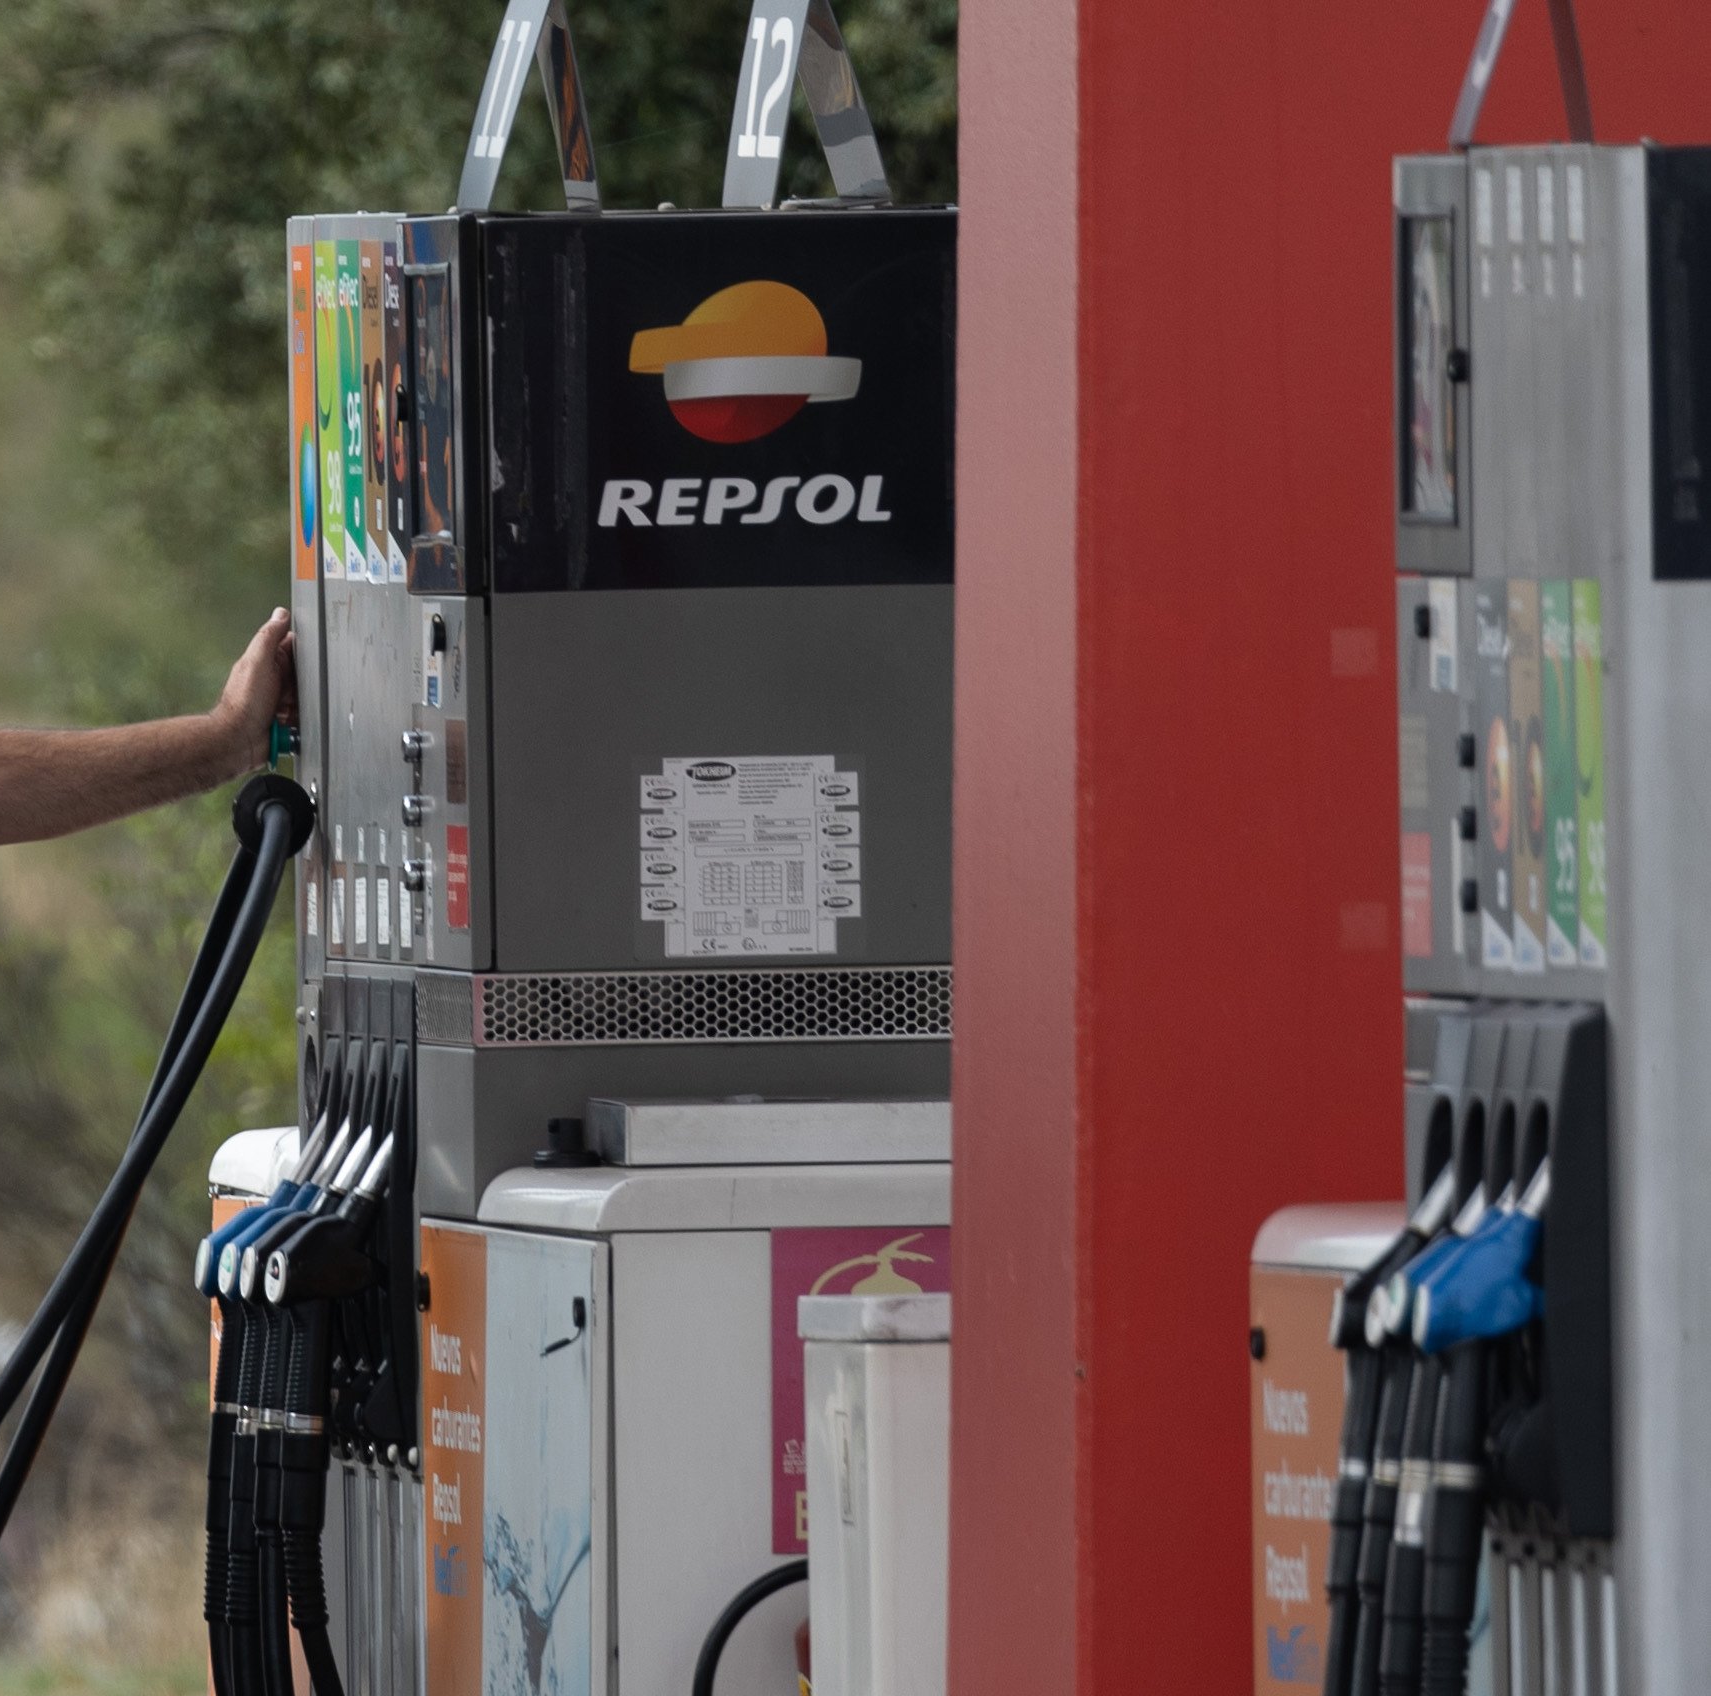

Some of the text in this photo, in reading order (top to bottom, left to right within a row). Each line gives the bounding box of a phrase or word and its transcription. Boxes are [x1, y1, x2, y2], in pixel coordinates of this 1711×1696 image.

[473, 19, 532, 159] 11
[737, 16, 794, 158] 12
[346, 391, 362, 457] 95
[327, 449, 343, 516] 98
[597, 474, 893, 527] REPSOL
[430, 1323, 462, 1375] Nuevos
[431, 1394, 482, 1454] carburantes
[432, 1471, 463, 1537] Repsol
